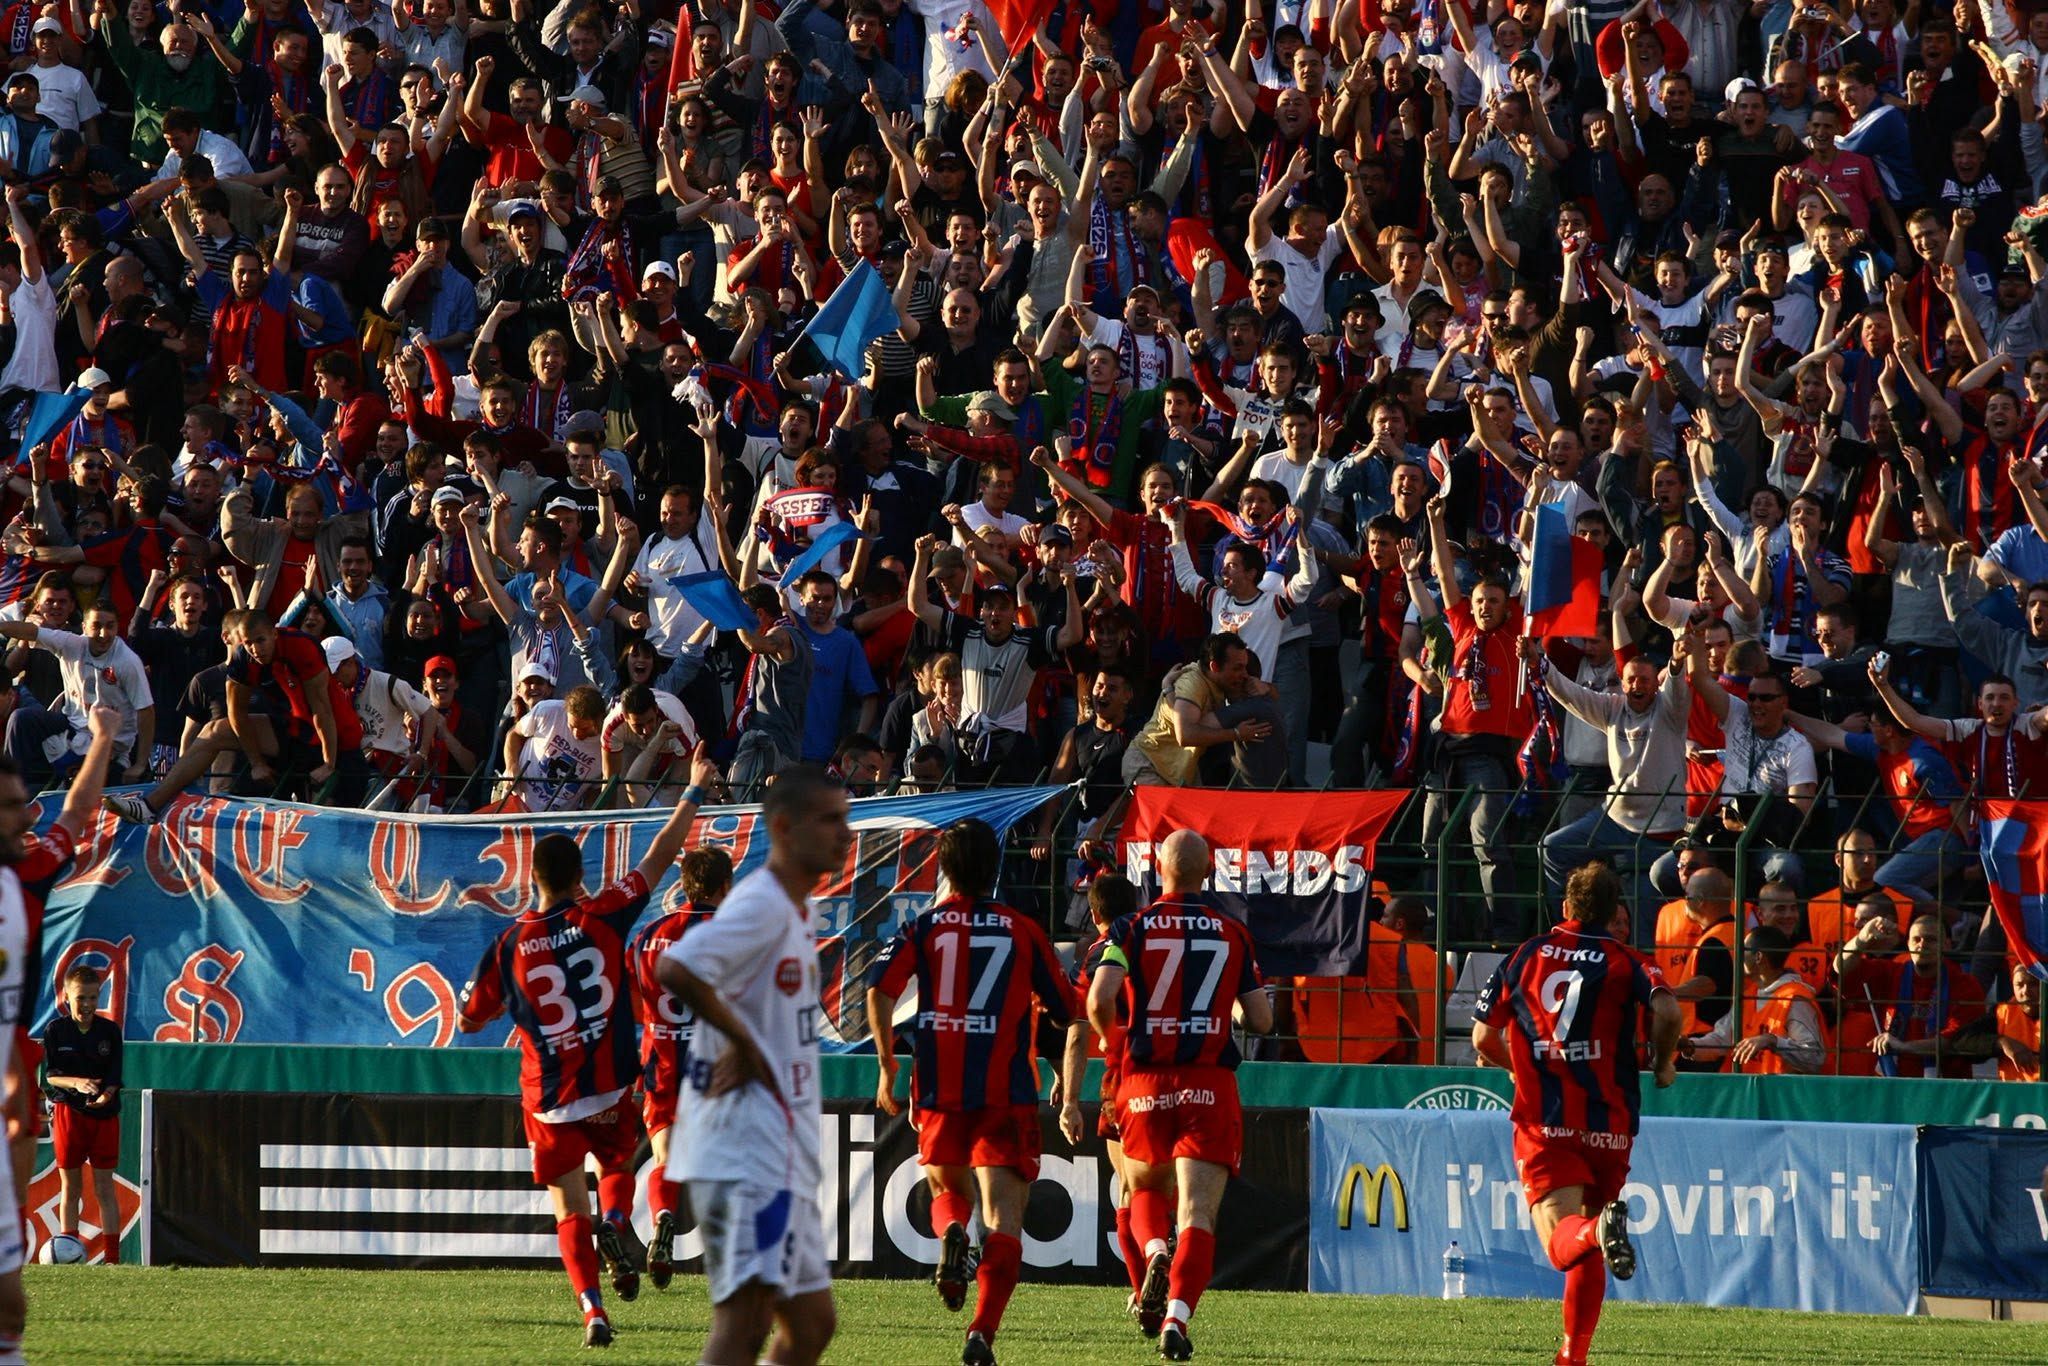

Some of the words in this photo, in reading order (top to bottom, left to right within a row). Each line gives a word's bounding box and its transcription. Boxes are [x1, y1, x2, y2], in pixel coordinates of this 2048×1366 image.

[1126, 841, 1367, 896] FENDS
[518, 926, 584, 957] HORVÁTH
[931, 911, 1013, 929] KOLLER
[1143, 915, 1224, 932] KUTTOR
[934, 931, 1013, 1011] 17
[1145, 938, 1230, 1011] 77
[1540, 944, 1606, 964] SITKU
[1799, 956, 1819, 975] 32
[526, 946, 614, 1036] 33
[1541, 969, 1584, 1042] 9
[1618, 1168, 1798, 1237] ovin'
[1831, 1171, 1881, 1241] it
